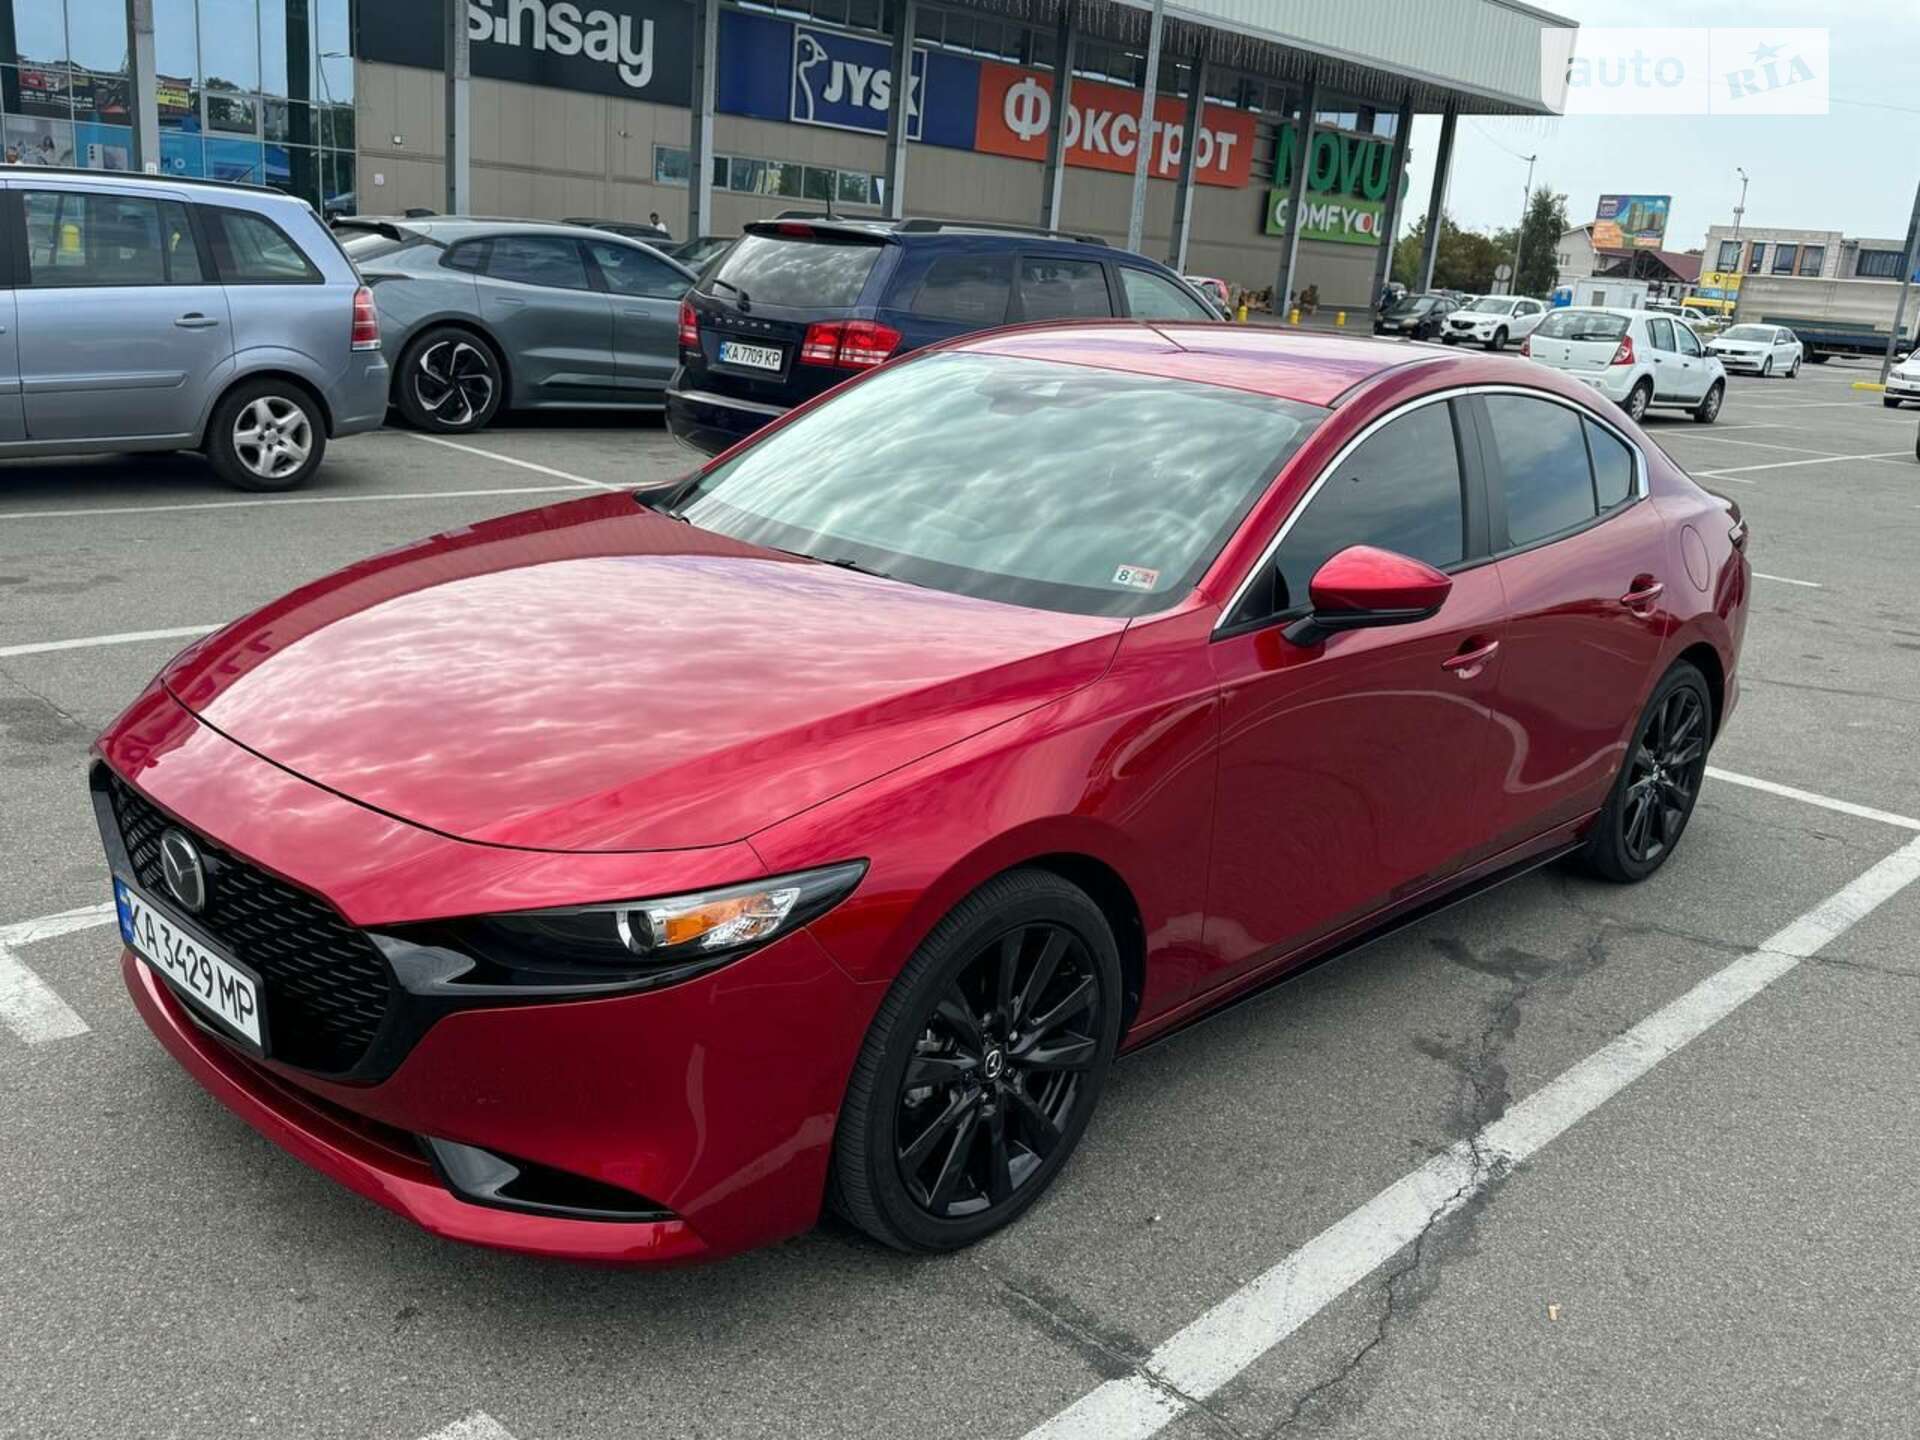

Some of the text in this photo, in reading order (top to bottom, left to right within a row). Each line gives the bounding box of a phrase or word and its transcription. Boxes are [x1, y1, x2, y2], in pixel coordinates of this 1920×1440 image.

[1272, 122, 1410, 202] NOVU
[132, 904, 254, 1024] KA 3429 MP
